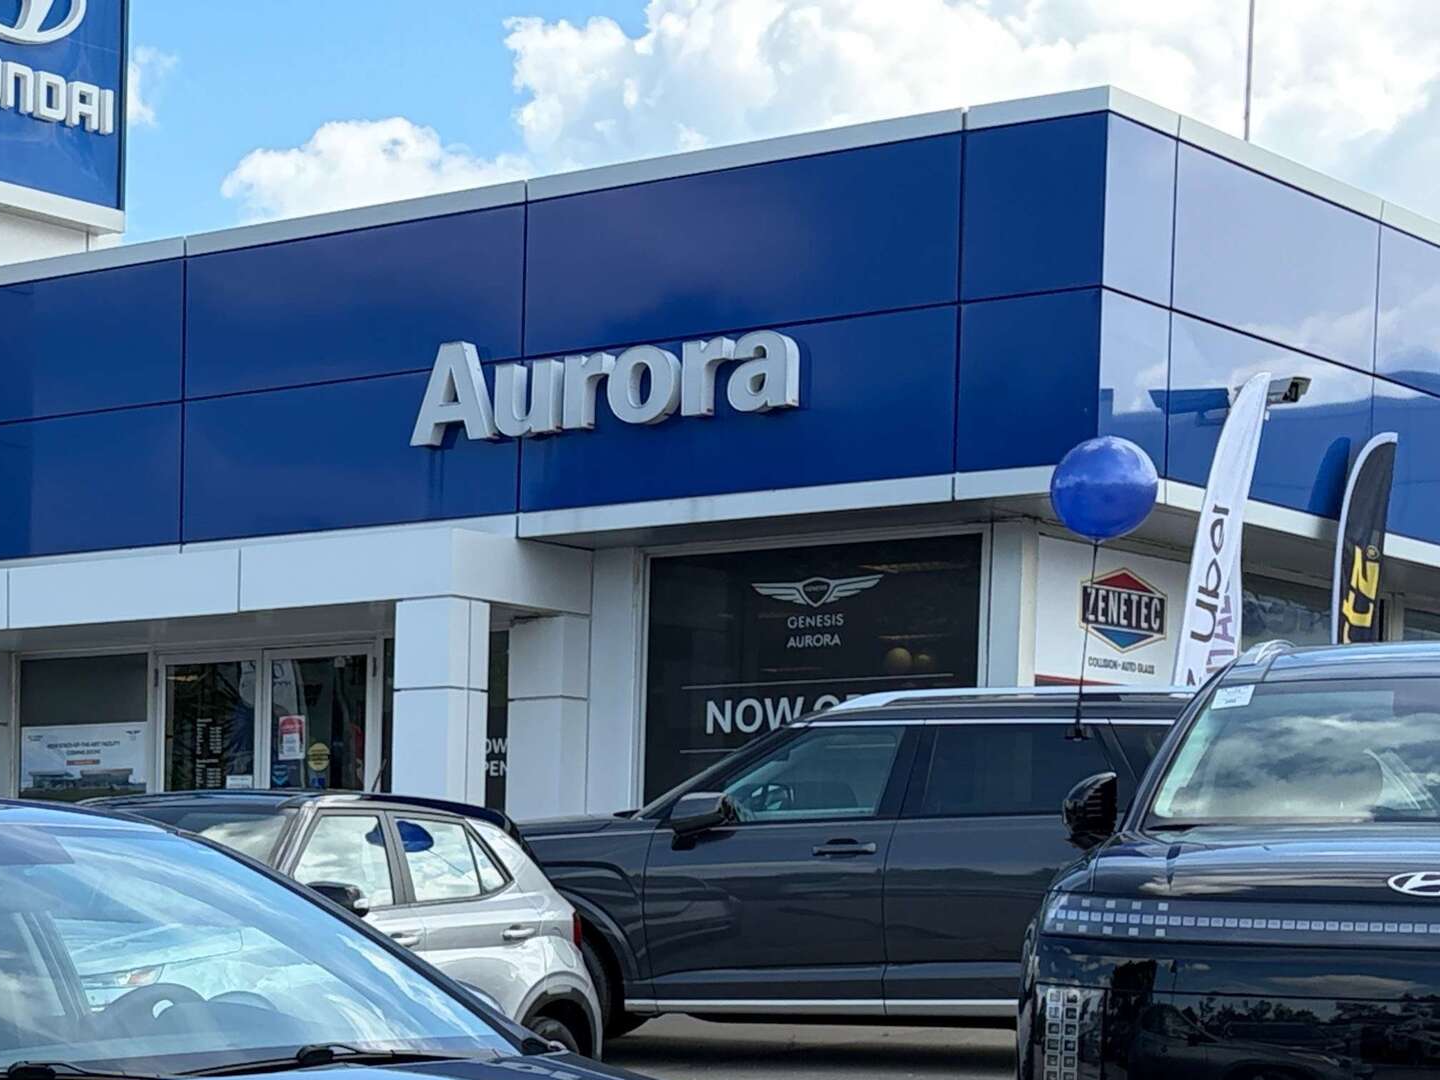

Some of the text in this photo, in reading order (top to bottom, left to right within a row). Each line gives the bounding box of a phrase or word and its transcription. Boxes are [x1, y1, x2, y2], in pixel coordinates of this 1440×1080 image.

[409, 330, 800, 447] Aurora
[787, 614, 844, 629] GENESIS
[1086, 588, 1160, 631] ZENETEC
[786, 634, 842, 649] AURORA
[706, 697, 805, 734] NOW
